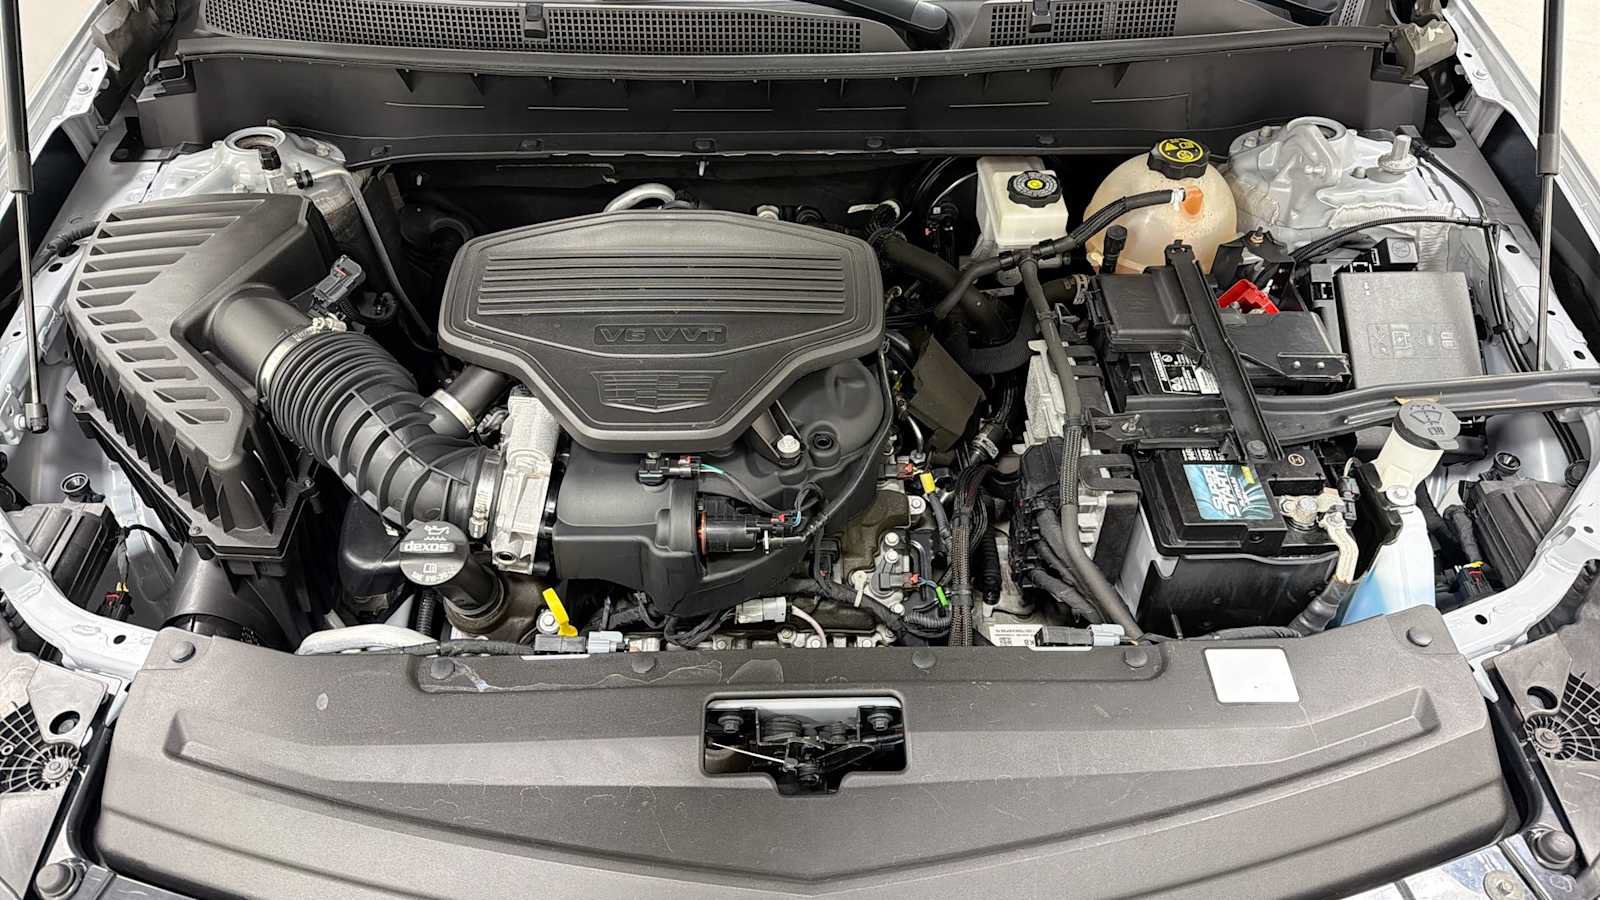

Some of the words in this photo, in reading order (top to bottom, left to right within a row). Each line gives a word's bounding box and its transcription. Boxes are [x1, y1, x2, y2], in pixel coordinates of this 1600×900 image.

[600, 328, 646, 342] V6
[653, 328, 722, 342] VVT
[1202, 466, 1224, 511] SUPER
[1214, 469, 1242, 517] START
[404, 540, 449, 553] dexos
